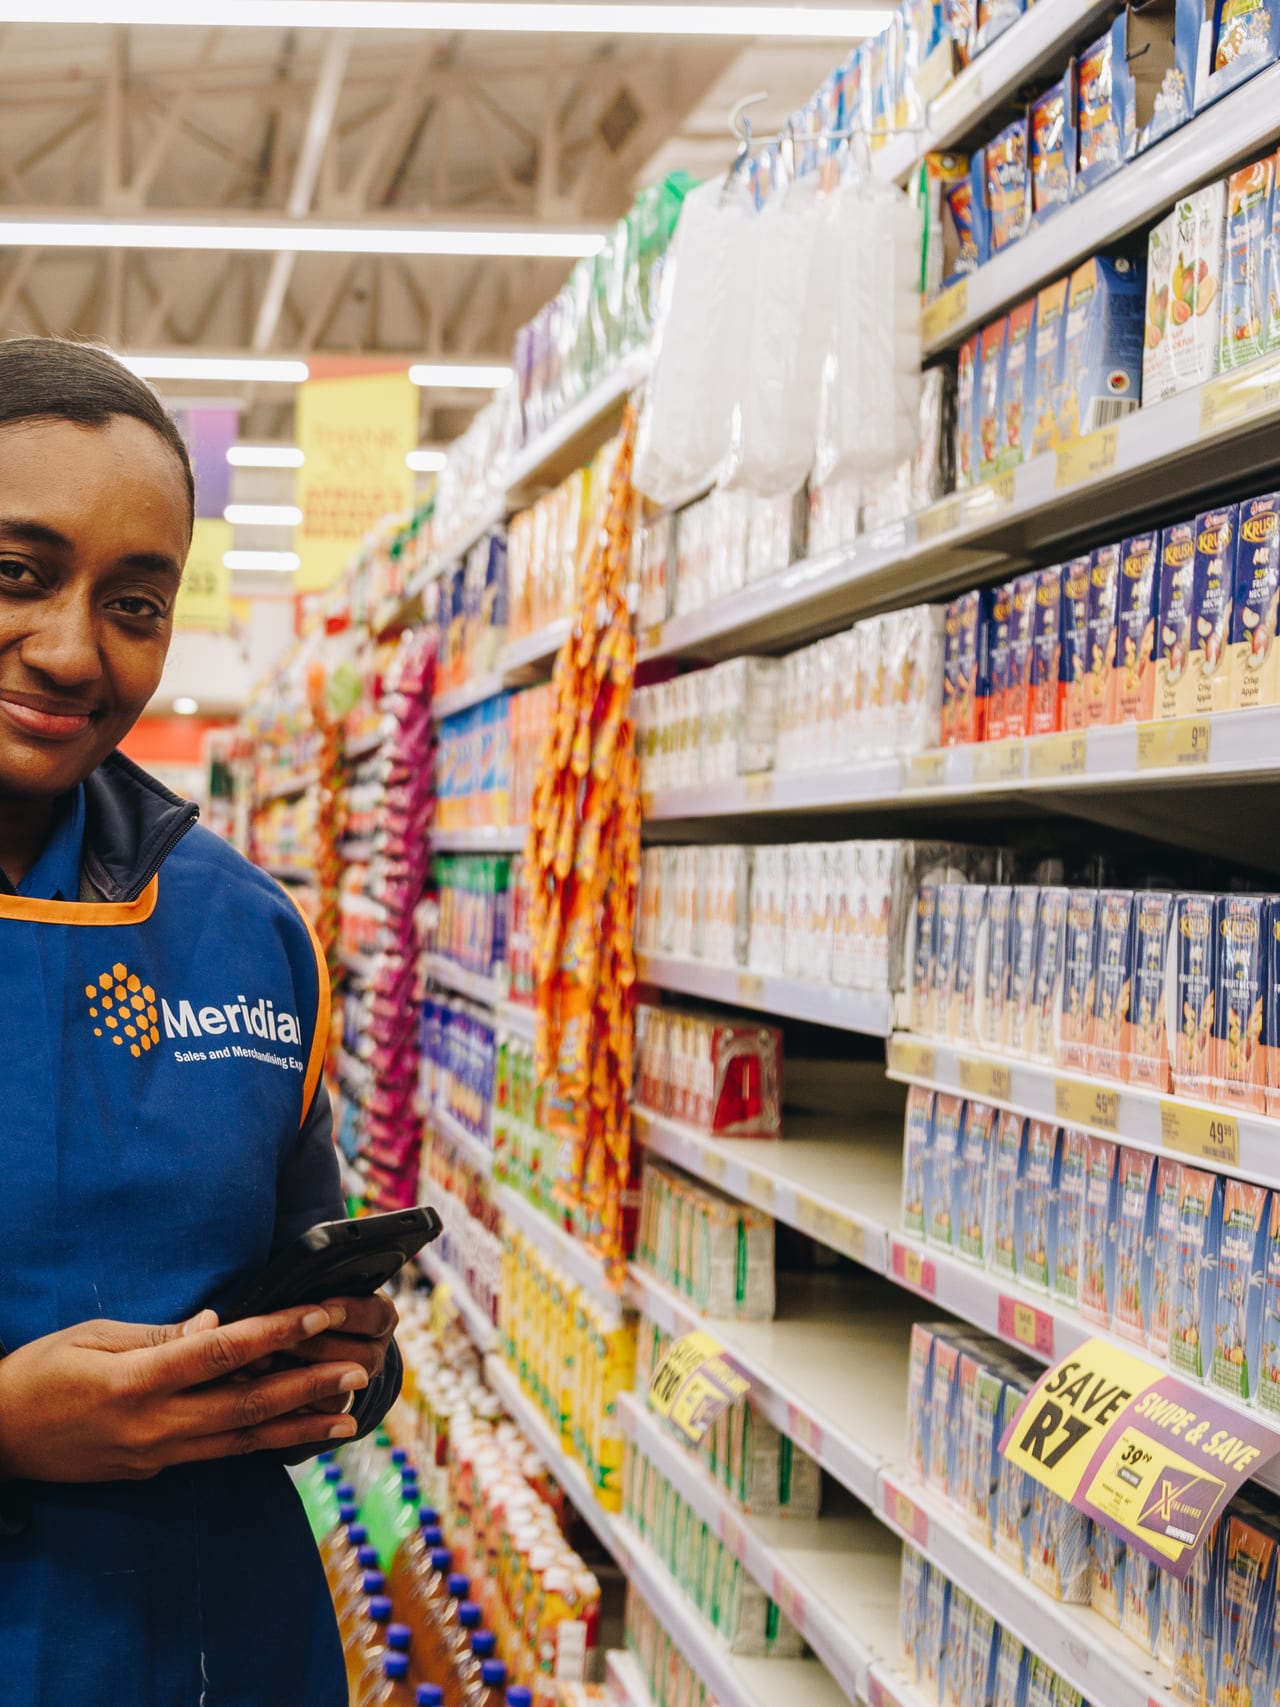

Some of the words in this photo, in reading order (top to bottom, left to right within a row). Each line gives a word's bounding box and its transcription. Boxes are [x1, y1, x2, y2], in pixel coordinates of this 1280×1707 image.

[1243, 516, 1278, 540] KRUSH
[1165, 541, 1194, 564] KRUSH
[1222, 918, 1258, 938] KRUSH
[161, 995, 302, 1046] Meridia
[174, 1050, 207, 1062] Sales
[209, 1046, 231, 1059] and
[232, 1046, 288, 1069] Merchandising
[1045, 1363, 1132, 1426] SAVE
[1020, 1400, 1092, 1470] R7
[1134, 1392, 1196, 1435] SWIPE
[1185, 1421, 1210, 1447] &
[1202, 1430, 1261, 1472] SAVE
